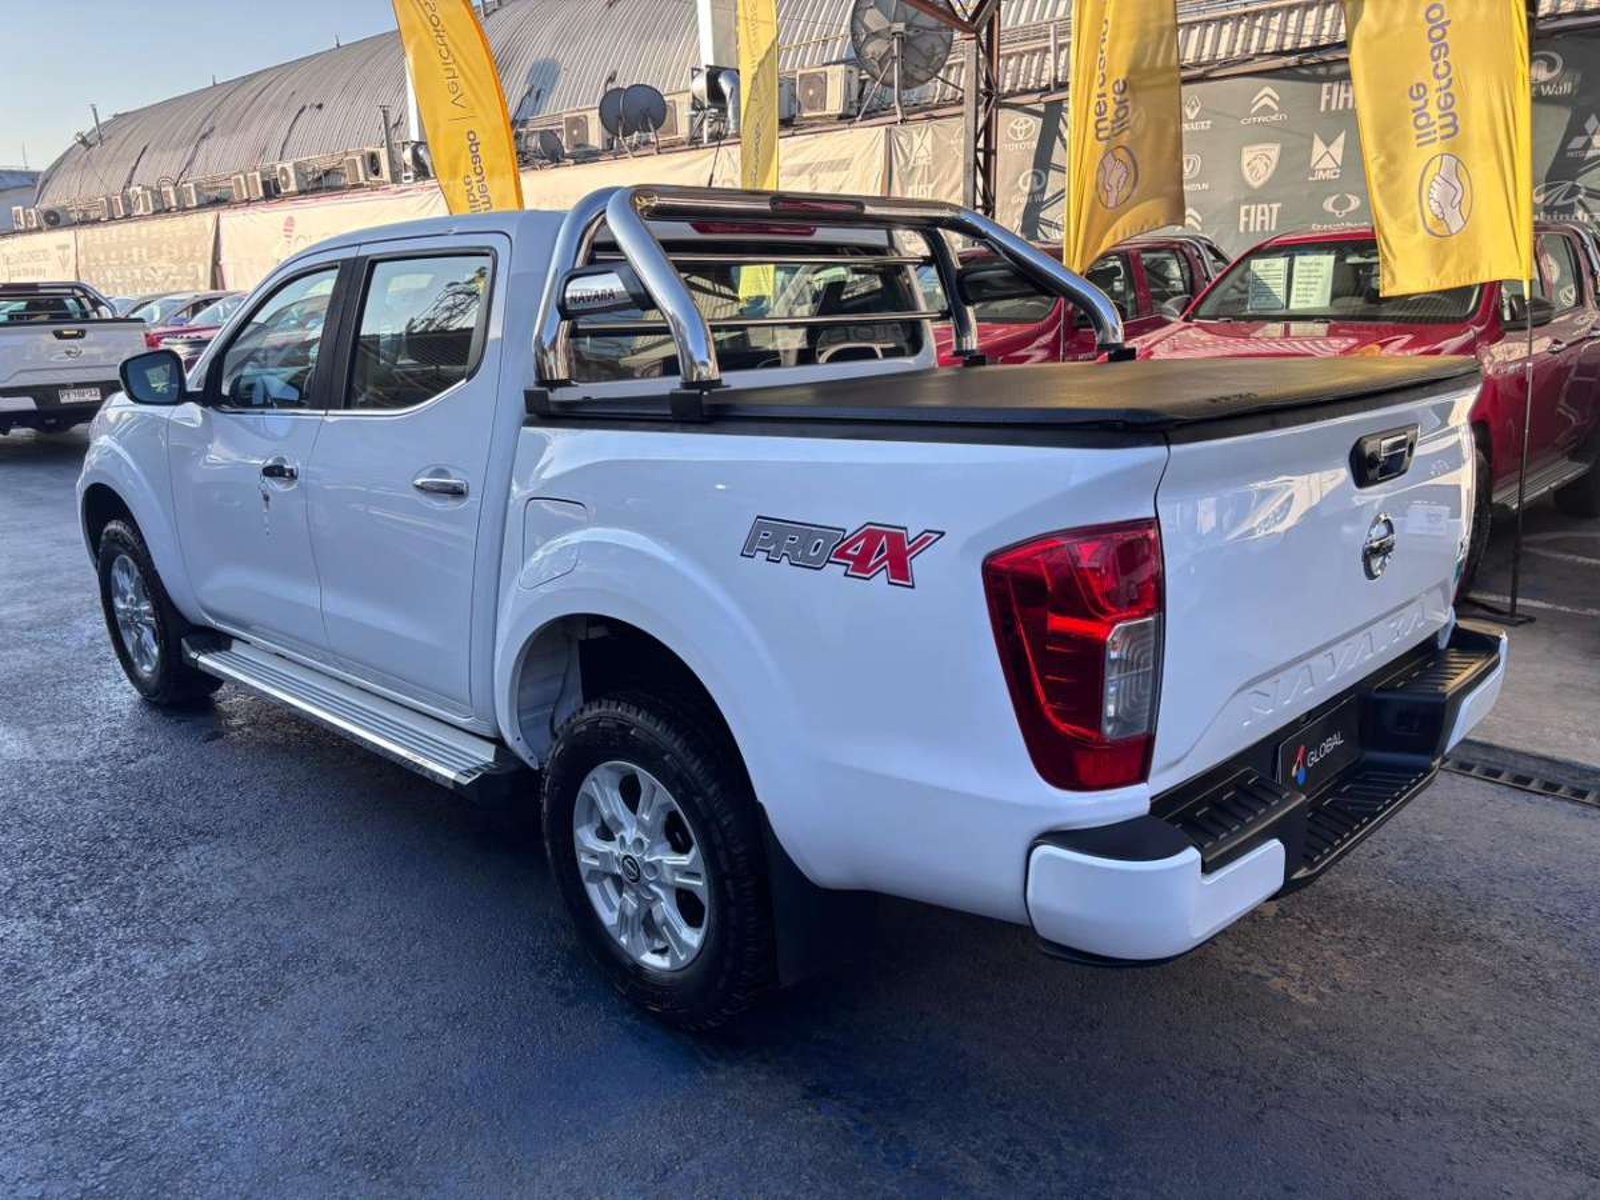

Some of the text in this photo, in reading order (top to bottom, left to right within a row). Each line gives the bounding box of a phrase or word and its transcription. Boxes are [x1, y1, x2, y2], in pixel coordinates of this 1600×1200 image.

[1308, 168, 1342, 181] JMC
[1239, 202, 1283, 233] FIAT
[569, 288, 617, 304] NAVARA
[1306, 731, 1345, 768] GLOBAL
